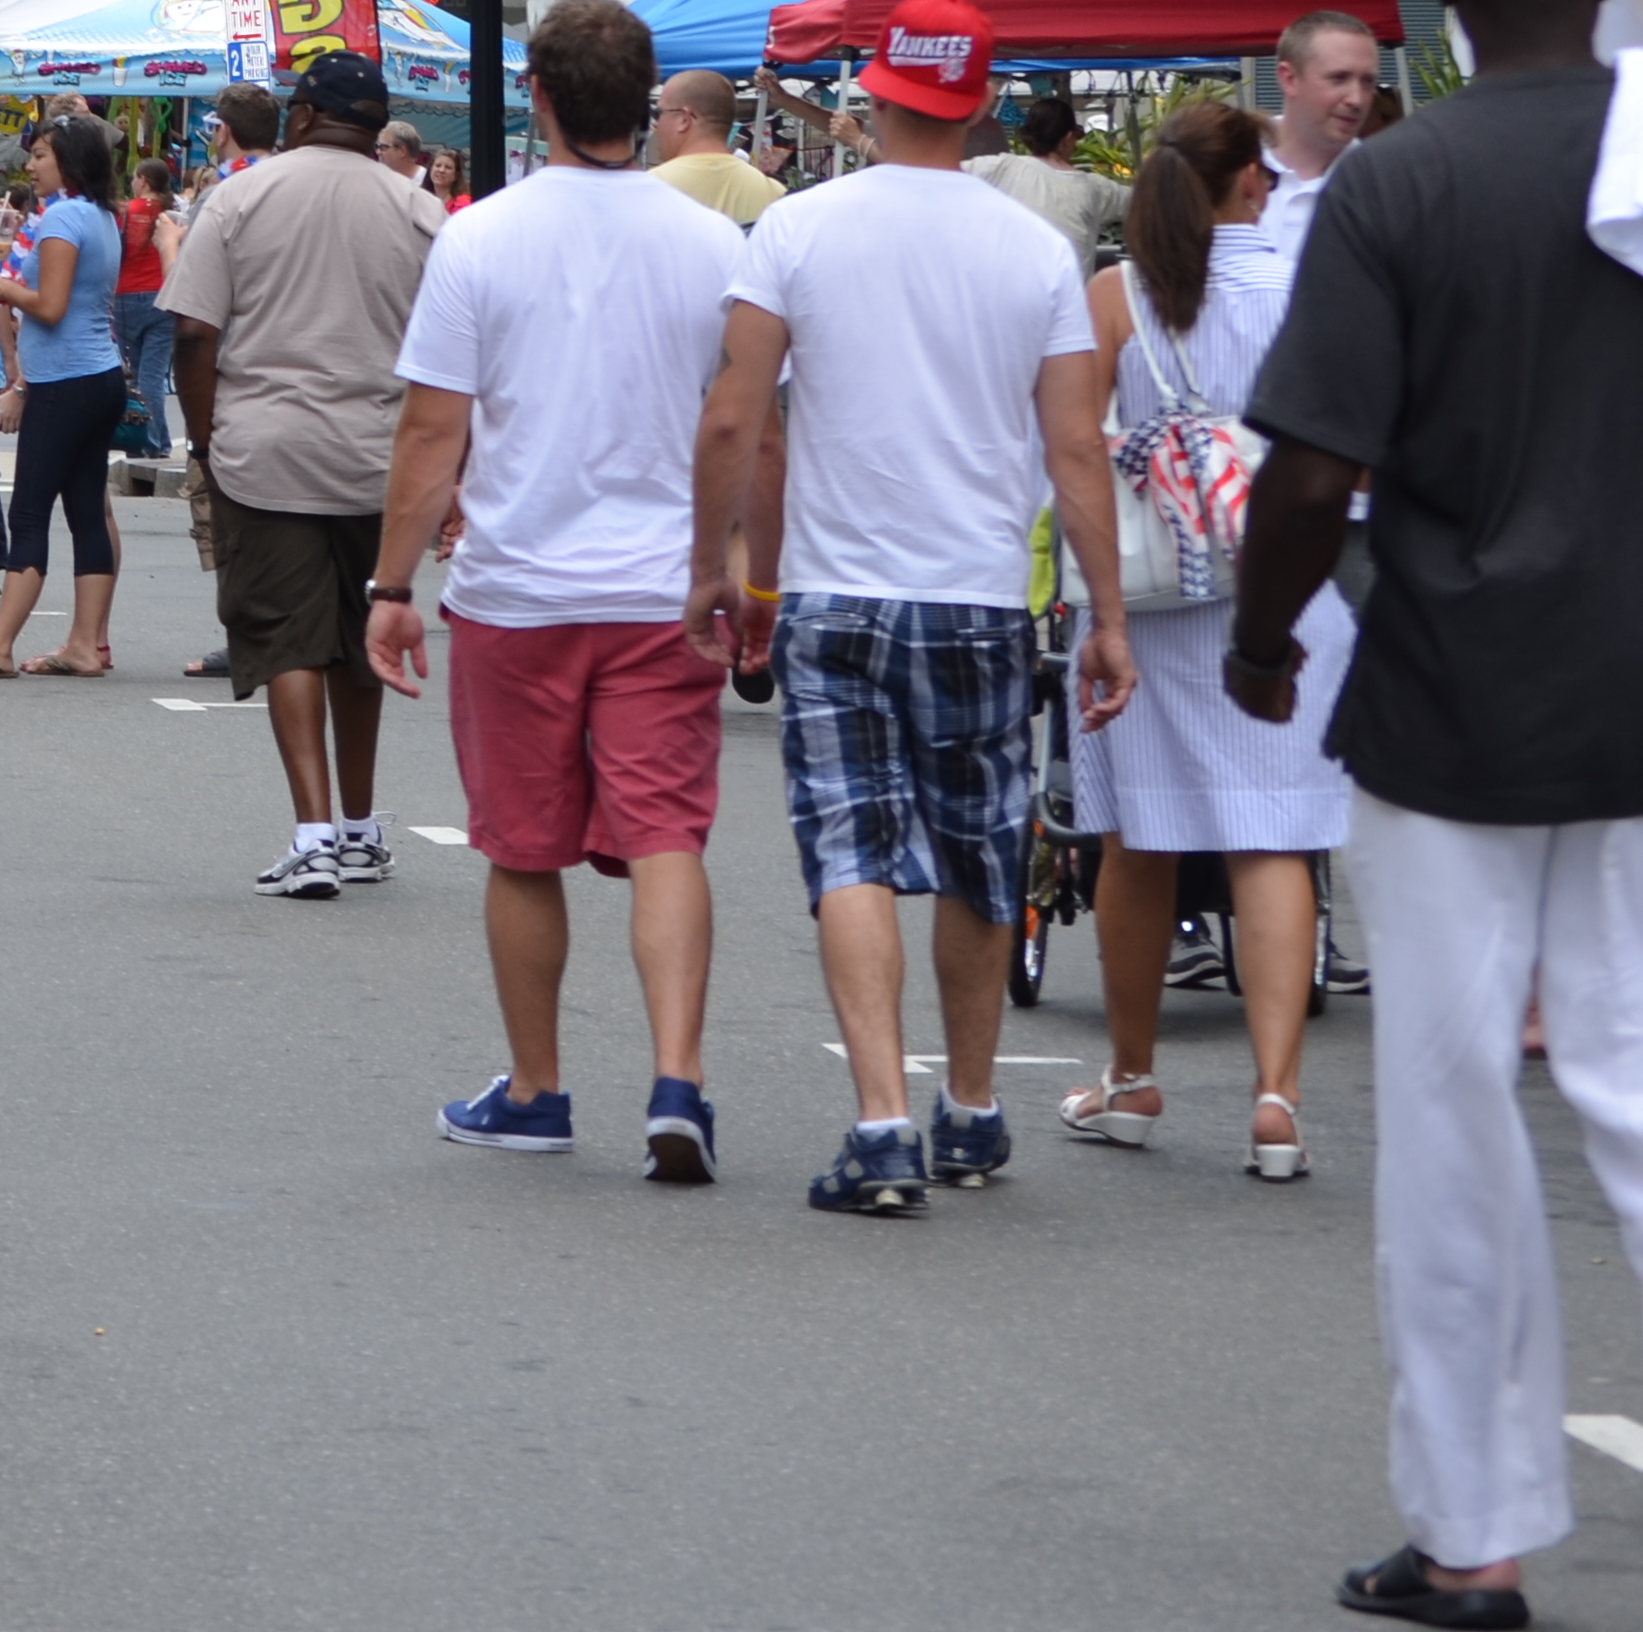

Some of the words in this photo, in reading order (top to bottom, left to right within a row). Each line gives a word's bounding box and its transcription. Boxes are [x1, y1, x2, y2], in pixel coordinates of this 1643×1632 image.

[230, 10, 262, 28] TIME
[887, 26, 973, 58] YANKEES
[230, 49, 241, 77] 2
